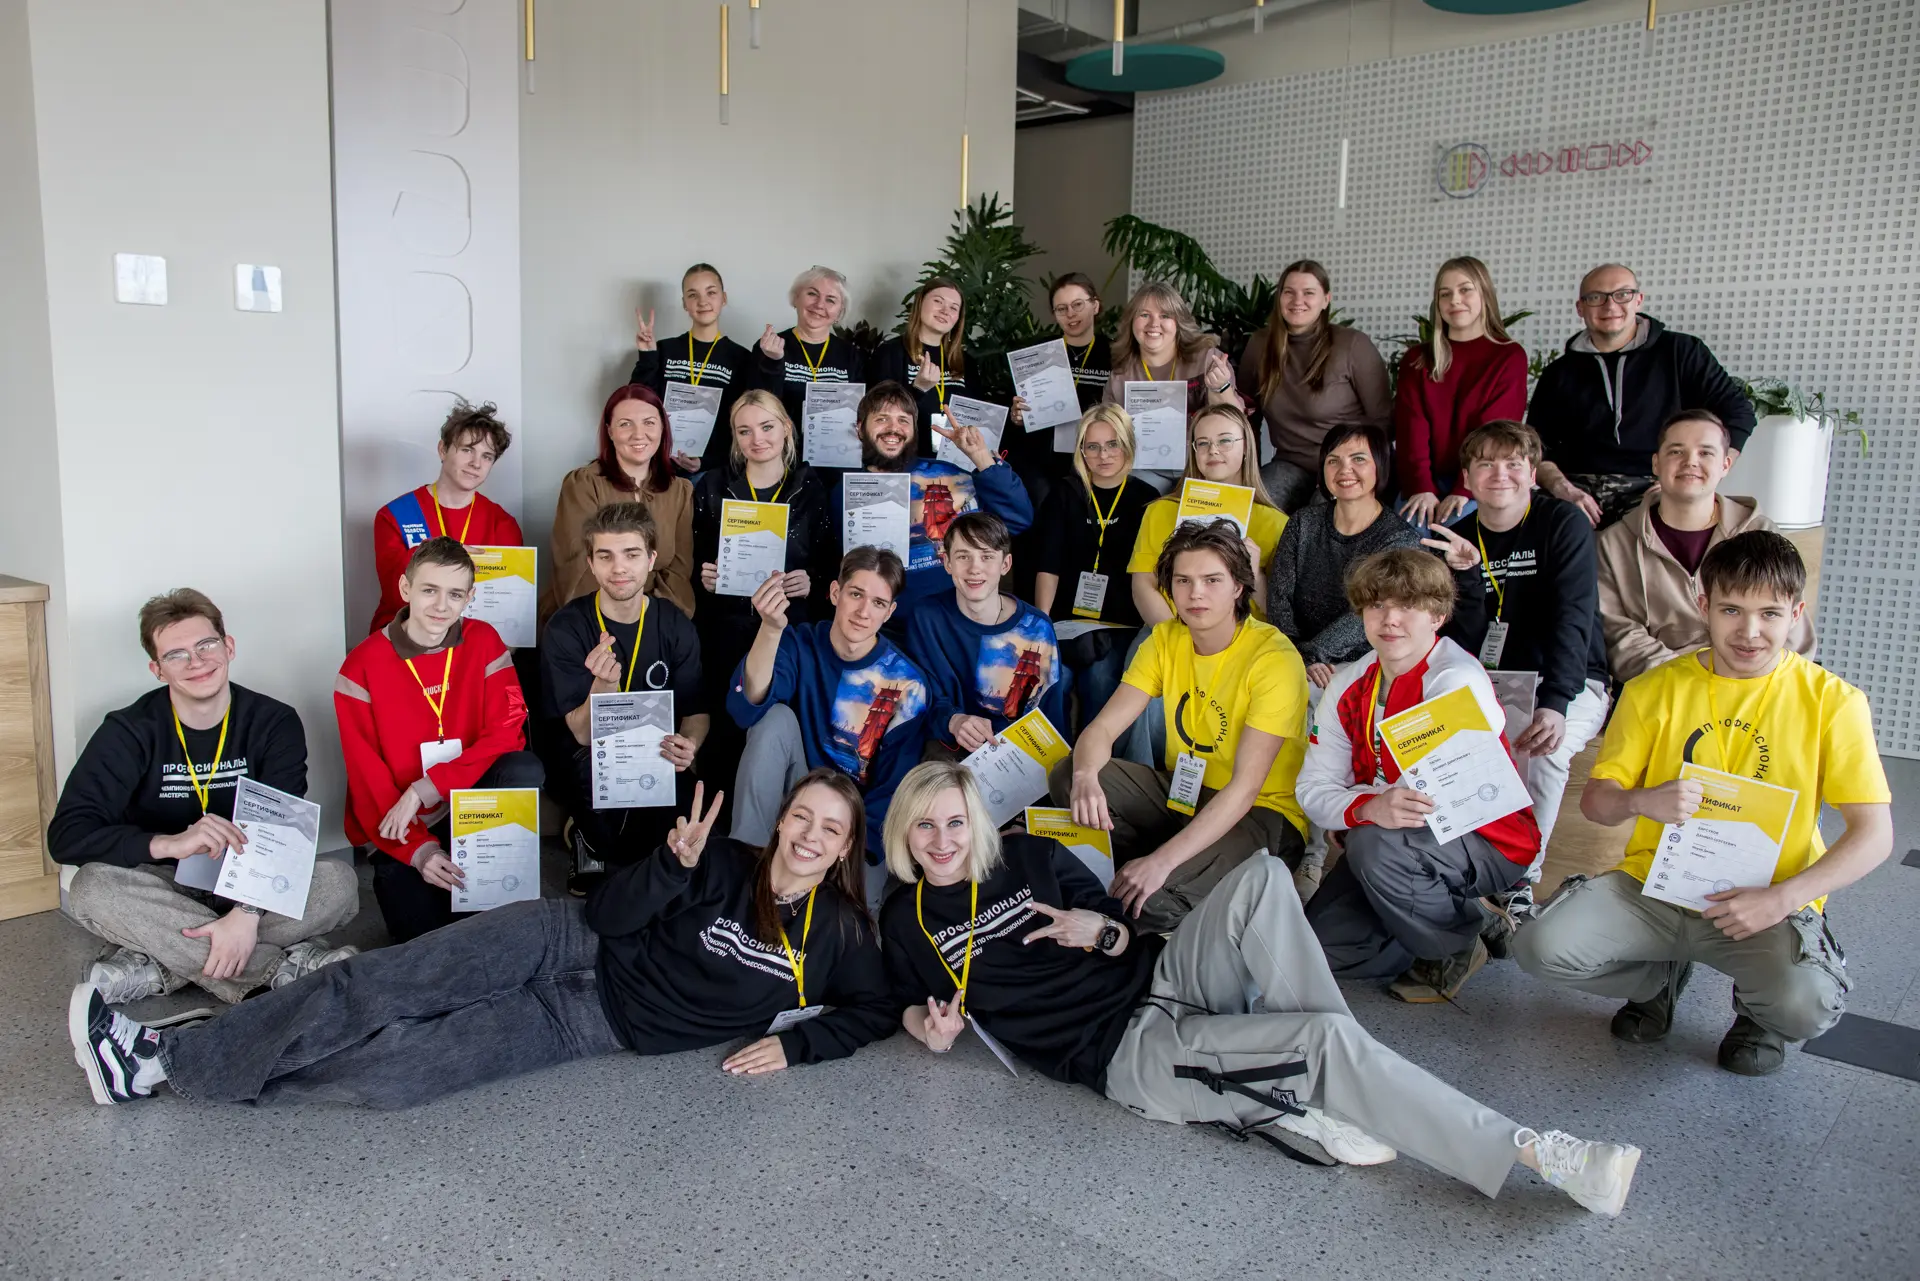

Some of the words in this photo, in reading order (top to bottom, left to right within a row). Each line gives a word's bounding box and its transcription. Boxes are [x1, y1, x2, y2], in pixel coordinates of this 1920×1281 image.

[1186, 497, 1223, 508] СЕРТИФИКАТ
[727, 518, 761, 526] СЕРТИФИКАТ
[598, 714, 640, 722] СЕРТИФИКАТ
[1019, 725, 1048, 758] СЕРТИФИКАТ
[1397, 724, 1446, 750] СЕРТИФИКАТ
[1701, 796, 1742, 812] ТИФИКАТ
[243, 800, 286, 820] СЕРТИФИКАТ
[458, 812, 504, 820] СЕРТИФИКАТ
[1035, 829, 1078, 838] СЕРТИФИКАТ
